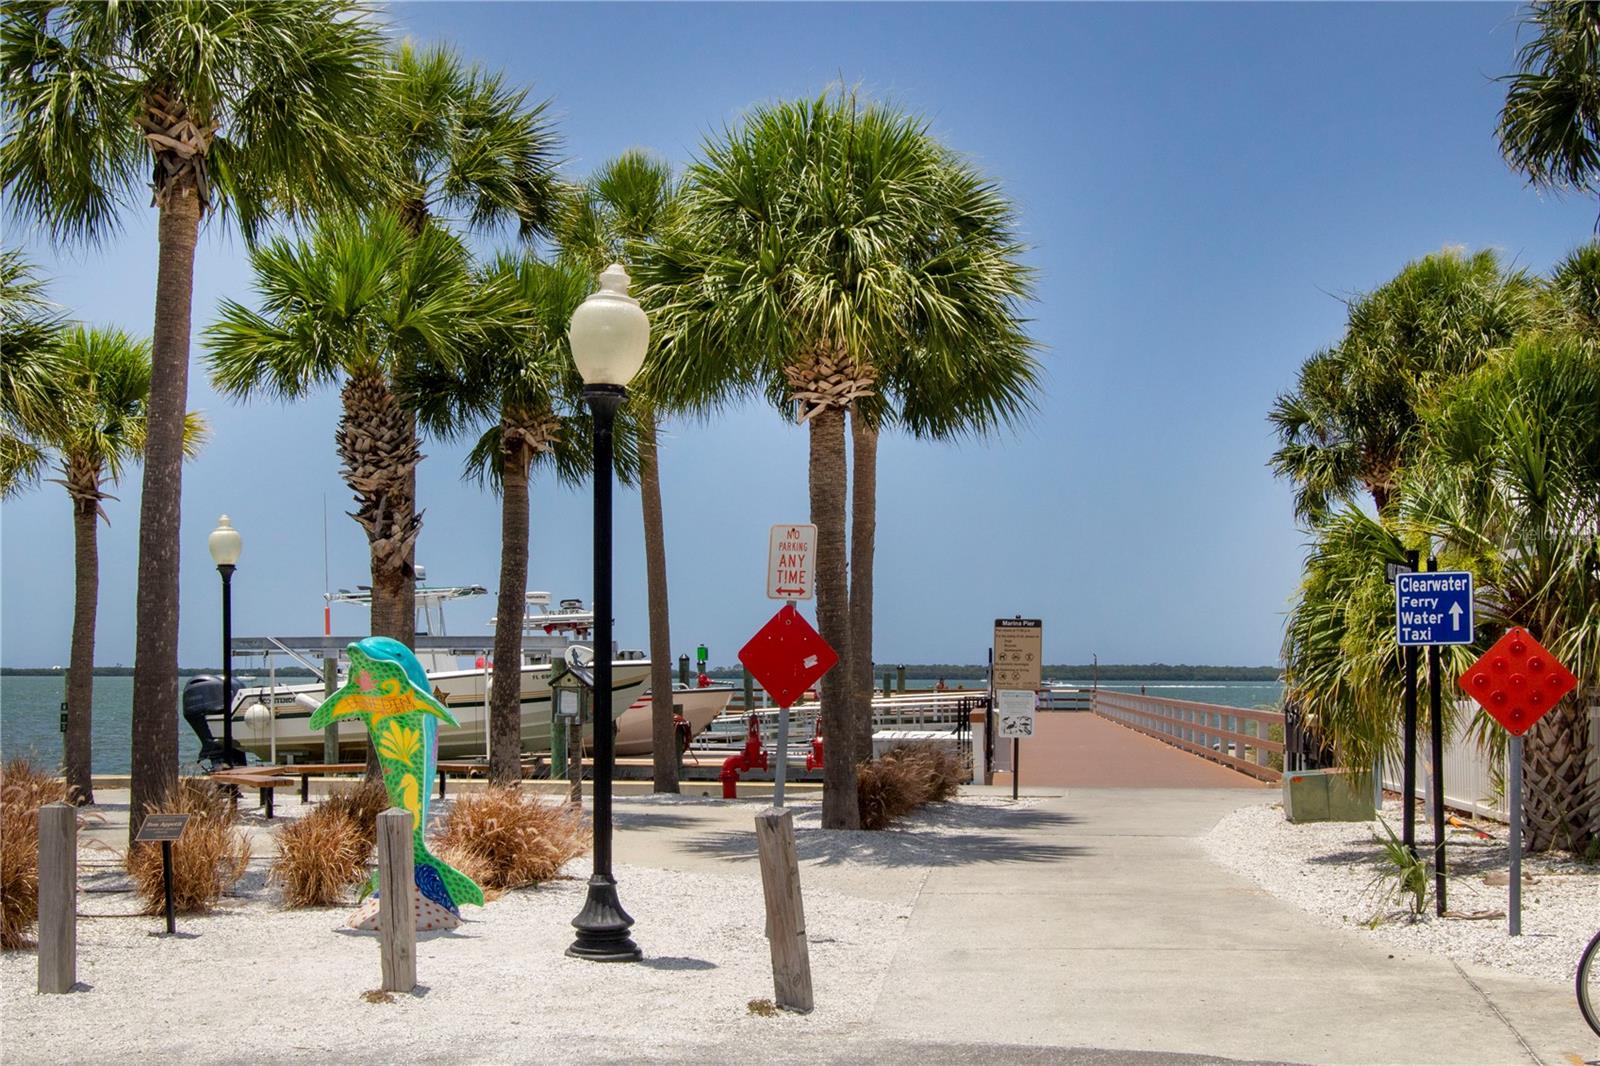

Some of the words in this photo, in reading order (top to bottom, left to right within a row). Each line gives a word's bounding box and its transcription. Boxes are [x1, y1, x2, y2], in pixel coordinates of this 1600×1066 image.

[787, 529, 800, 540] NO
[779, 542, 808, 551] PARKING
[778, 554, 806, 568] ANY
[777, 570, 806, 584] TIME
[1400, 576, 1467, 593] Clearwater
[1401, 596, 1439, 610] Ferry
[1401, 611, 1444, 625] Water
[1402, 627, 1432, 641] Taxi
